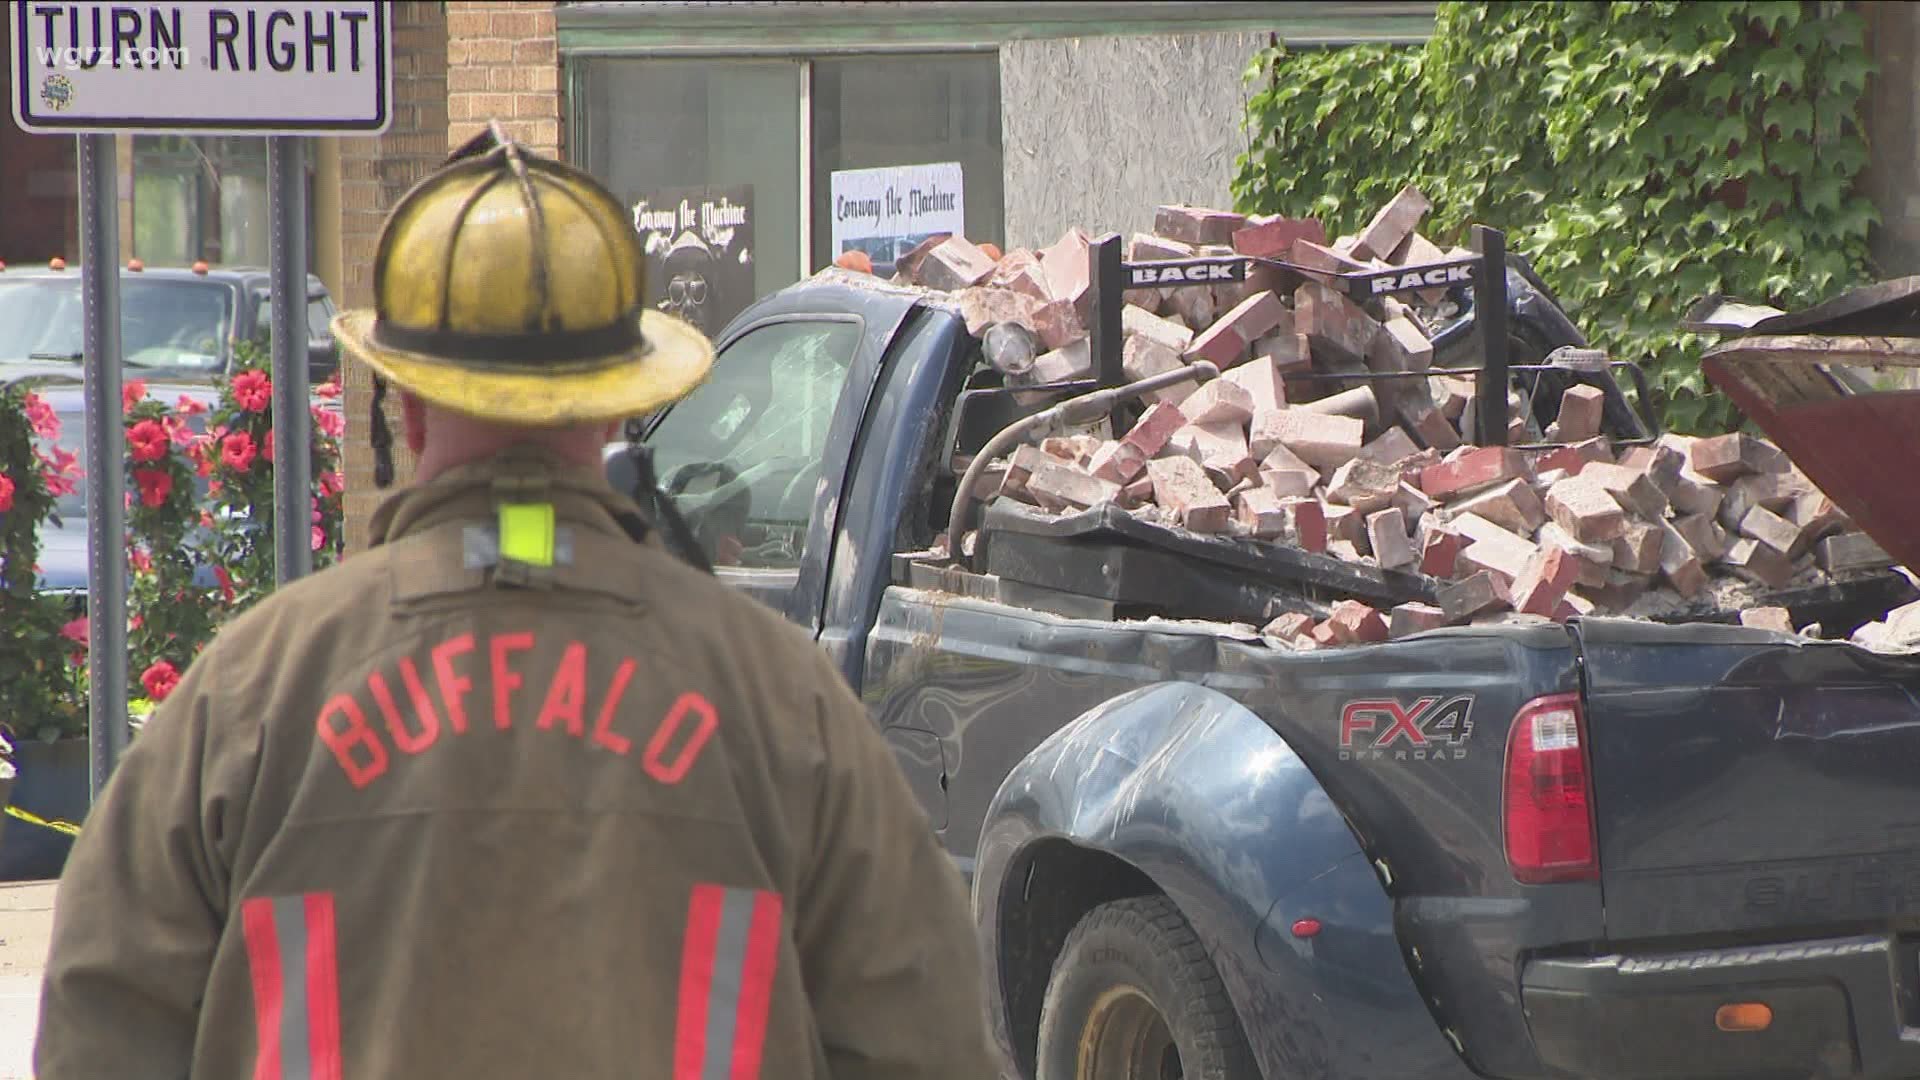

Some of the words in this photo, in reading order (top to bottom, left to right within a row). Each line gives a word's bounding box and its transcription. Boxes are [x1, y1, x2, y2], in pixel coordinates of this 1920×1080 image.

[34, 6, 182, 69] TURN
[209, 8, 369, 72] RIGHT
[632, 199, 676, 239] Conway
[837, 194, 881, 229] Conway
[909, 183, 956, 217] Machine
[1131, 263, 1235, 285] BACK
[1370, 263, 1473, 294] RACK
[316, 631, 720, 789] BUFFALO
[1338, 693, 1476, 749] FX4
[1338, 749, 1385, 761] OFF
[1394, 749, 1467, 761] ROAD
